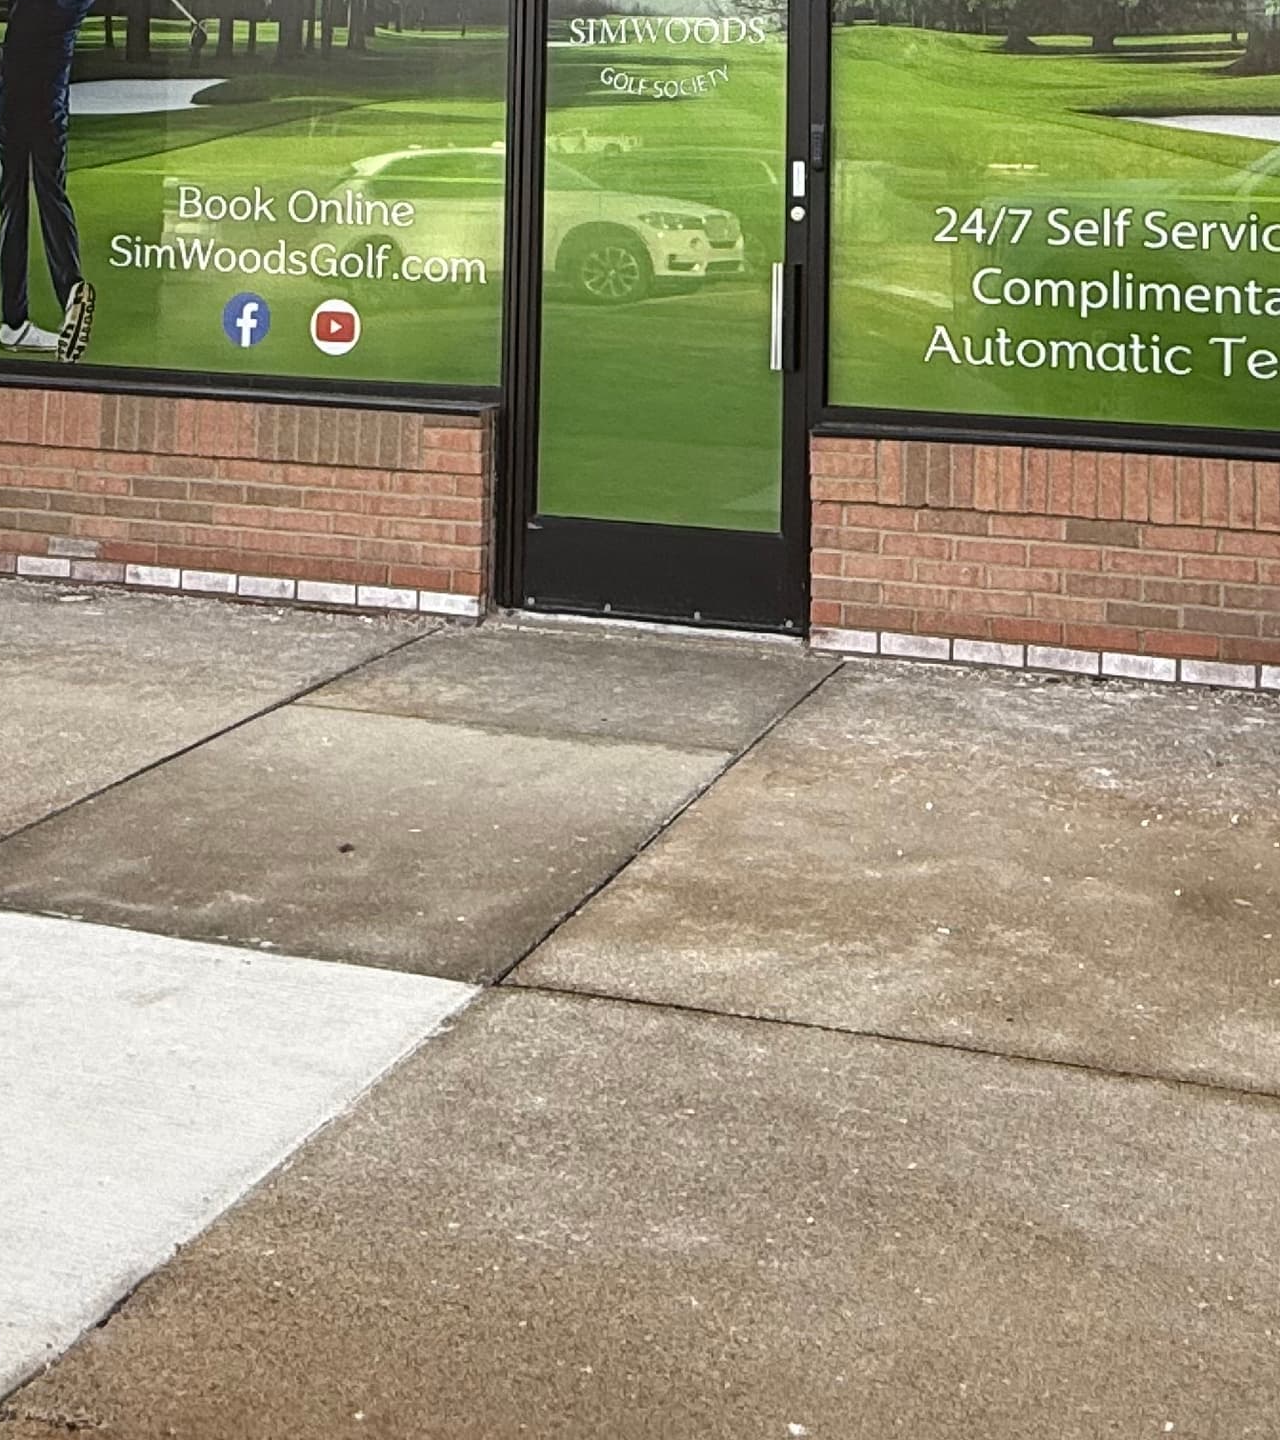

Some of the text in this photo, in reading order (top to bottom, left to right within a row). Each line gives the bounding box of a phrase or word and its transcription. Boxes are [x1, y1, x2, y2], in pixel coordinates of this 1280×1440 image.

[570, 16, 766, 45] SIMWOODS
[600, 64, 729, 99] GOLF SOCIETY
[178, 186, 415, 227] Book Online
[933, 206, 1032, 245] 24/7
[1047, 208, 1133, 247] Self
[108, 235, 487, 284] SimWoodsGolf.com
[924, 325, 1192, 375] Automatic
